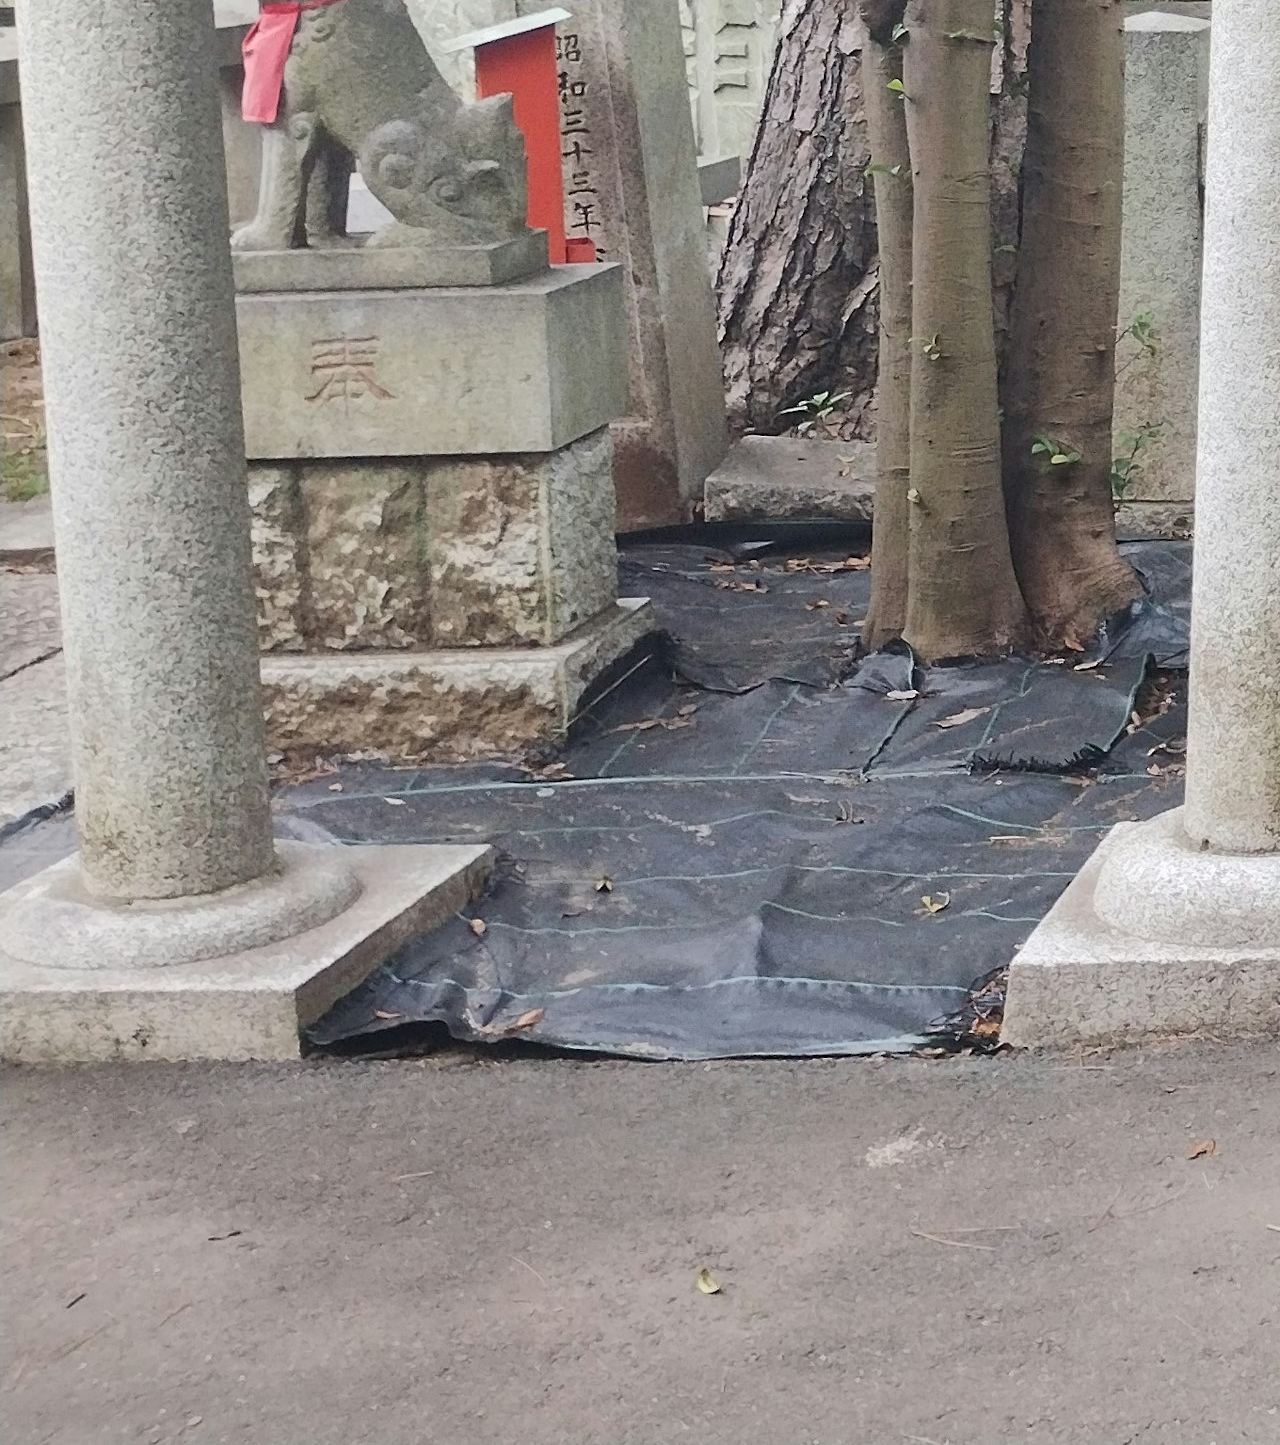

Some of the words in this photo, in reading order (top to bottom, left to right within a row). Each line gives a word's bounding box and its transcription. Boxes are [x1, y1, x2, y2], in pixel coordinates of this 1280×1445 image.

[555, 33, 607, 263] 昭和三十三年
[304, 333, 397, 418] 奉
